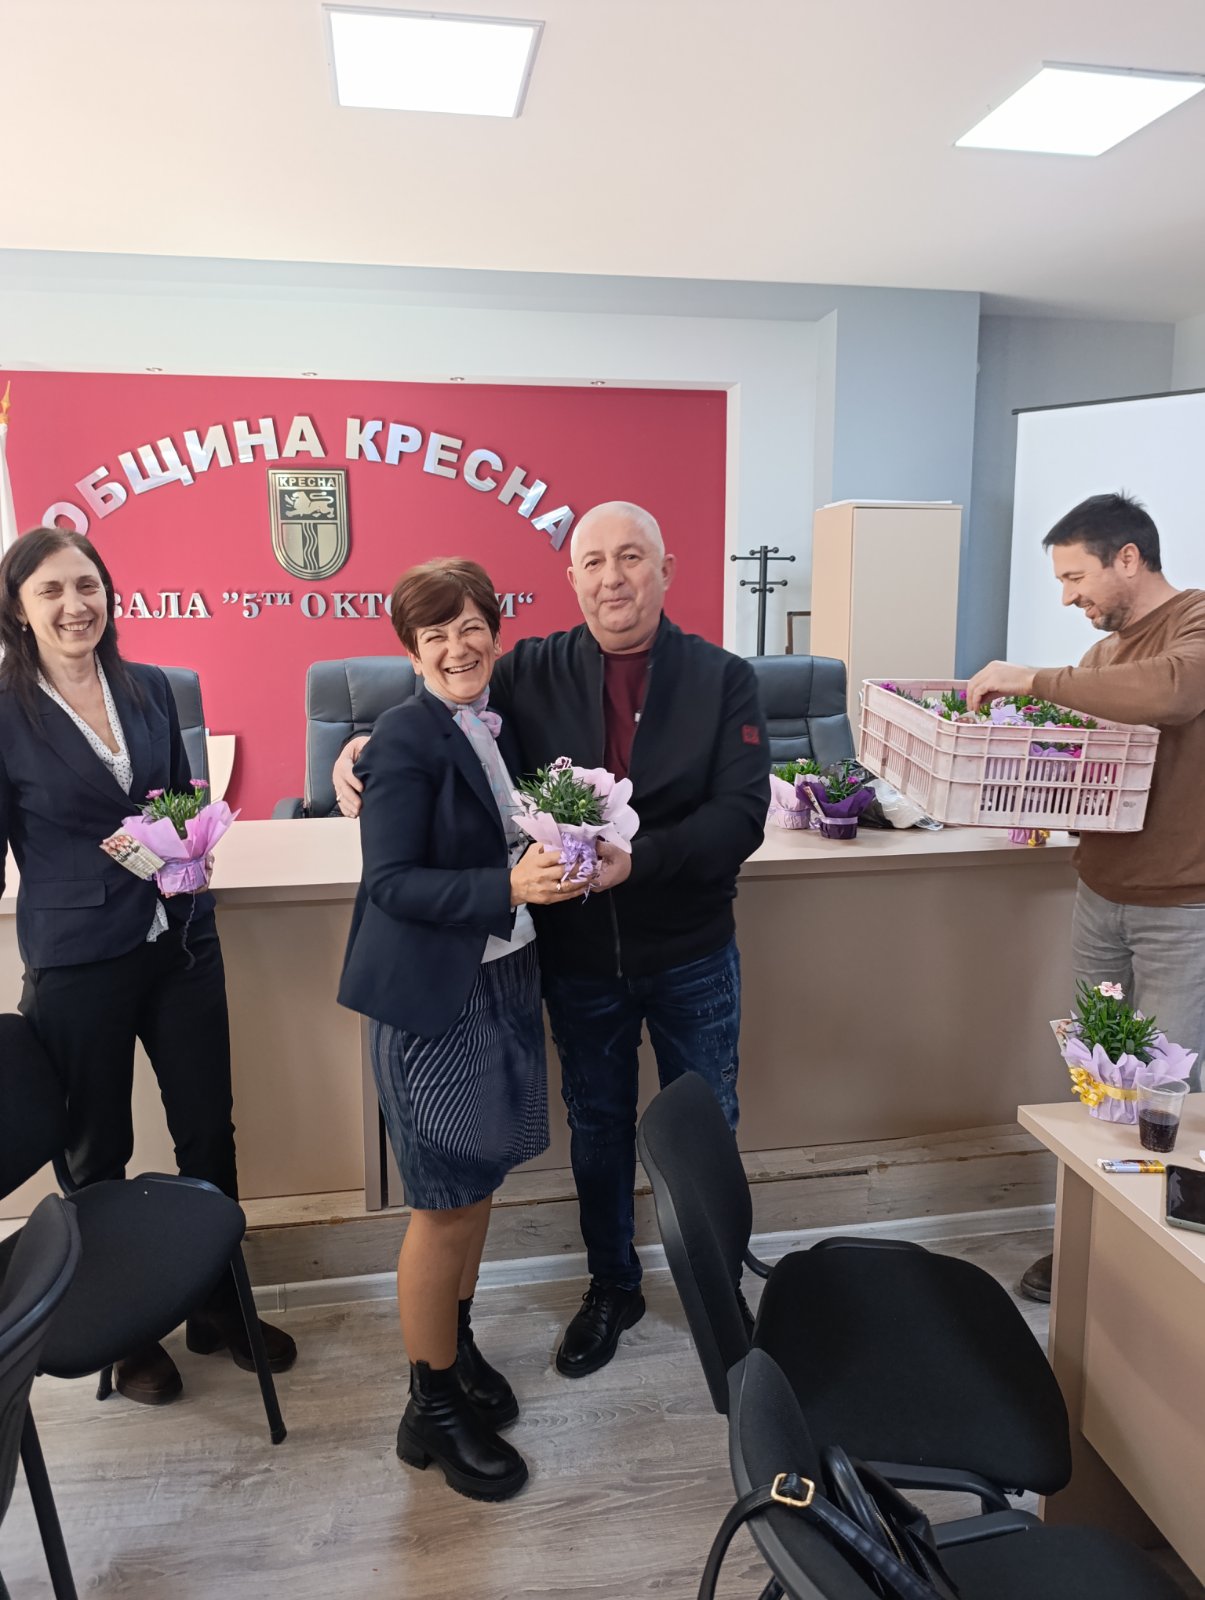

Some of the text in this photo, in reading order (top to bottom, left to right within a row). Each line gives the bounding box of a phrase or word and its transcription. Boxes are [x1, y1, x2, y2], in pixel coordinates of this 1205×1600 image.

[41, 415, 576, 552] ОБЩИНА КРЕСНА
[279, 477, 336, 487] КРЕСНА
